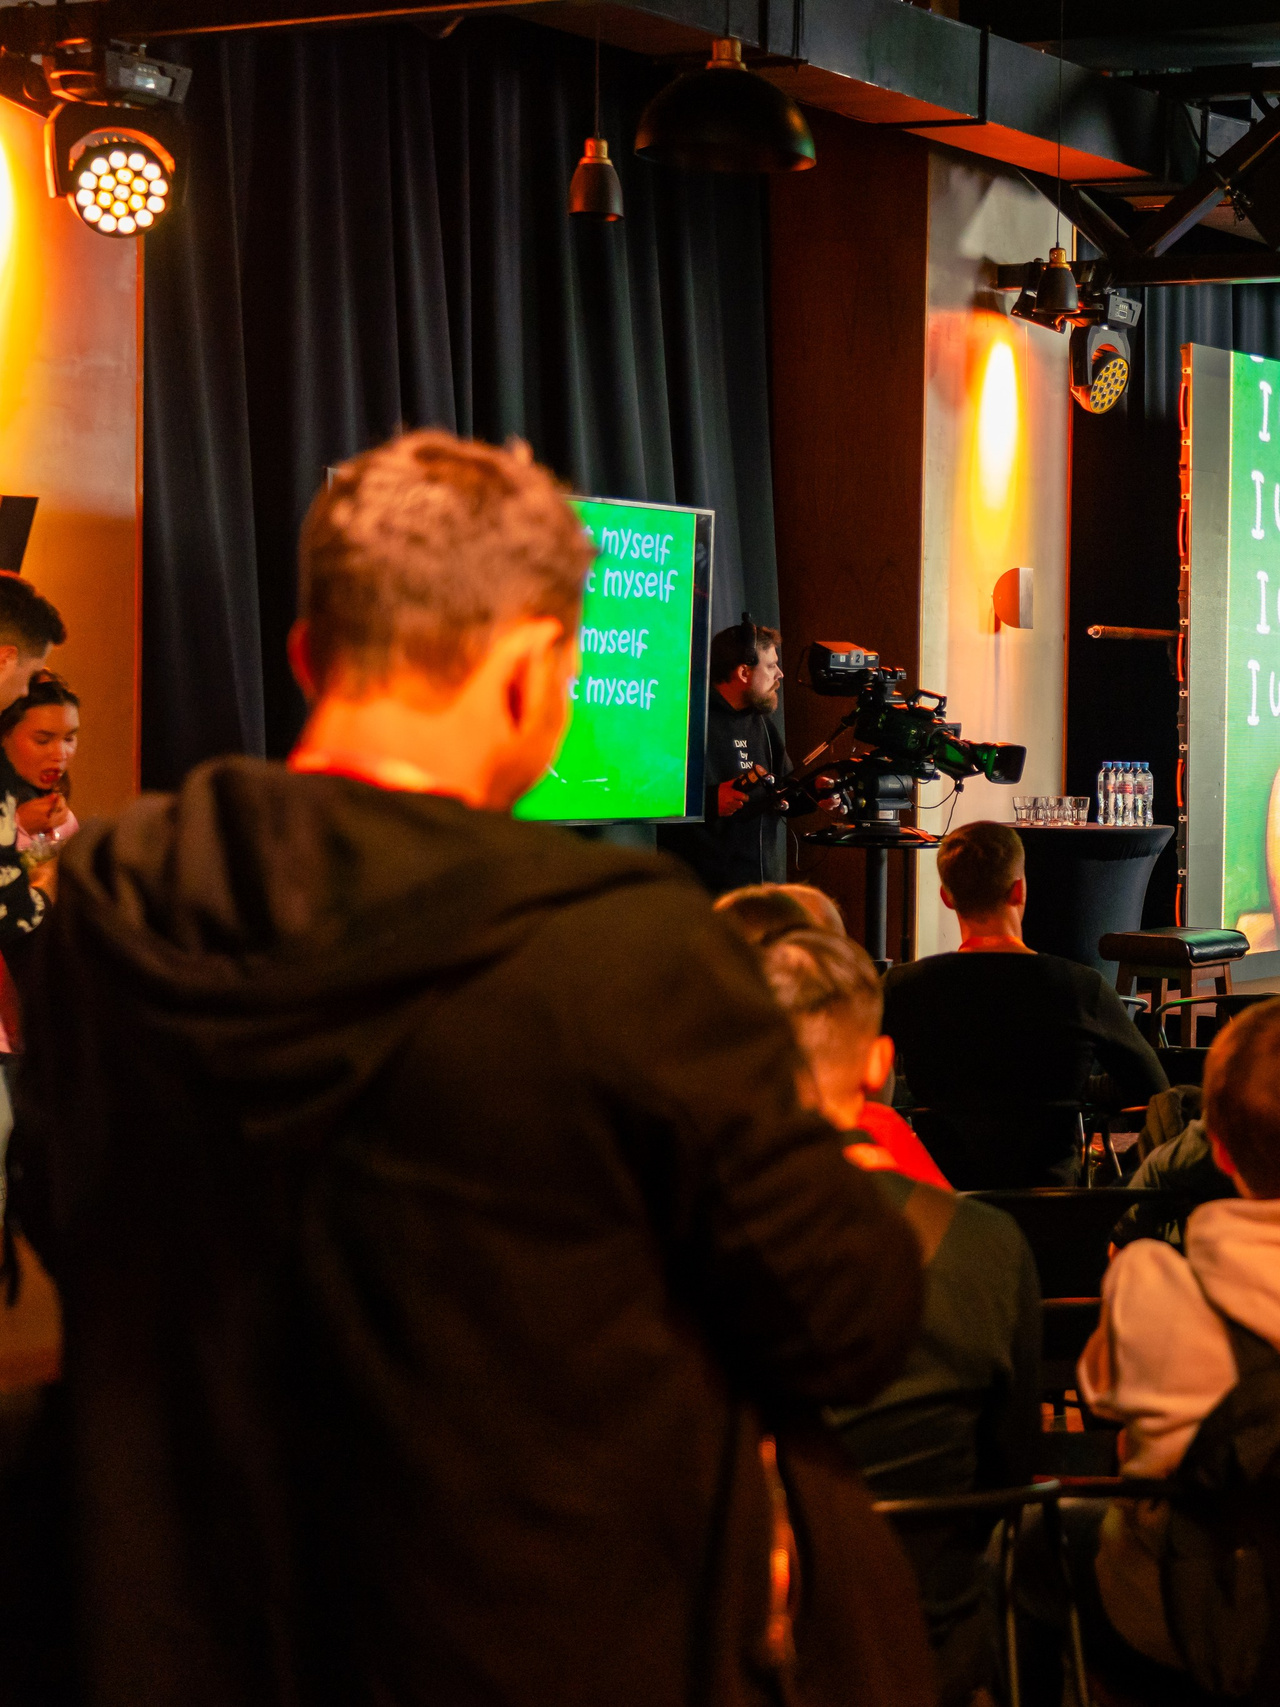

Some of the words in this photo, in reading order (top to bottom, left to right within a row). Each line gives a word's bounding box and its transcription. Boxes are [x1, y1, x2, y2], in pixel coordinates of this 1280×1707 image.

[1258, 381, 1272, 442] I
[1251, 470, 1265, 540] I
[602, 526, 673, 565] myself
[604, 567, 679, 603] myself
[1256, 570, 1271, 635] I
[580, 625, 649, 659] myself
[855, 654, 863, 664] 2
[586, 676, 659, 710] myself
[1247, 659, 1261, 727] I
[734, 739, 748, 748] DAY
[740, 750, 749, 760] by
[740, 761, 754, 769] DAY
